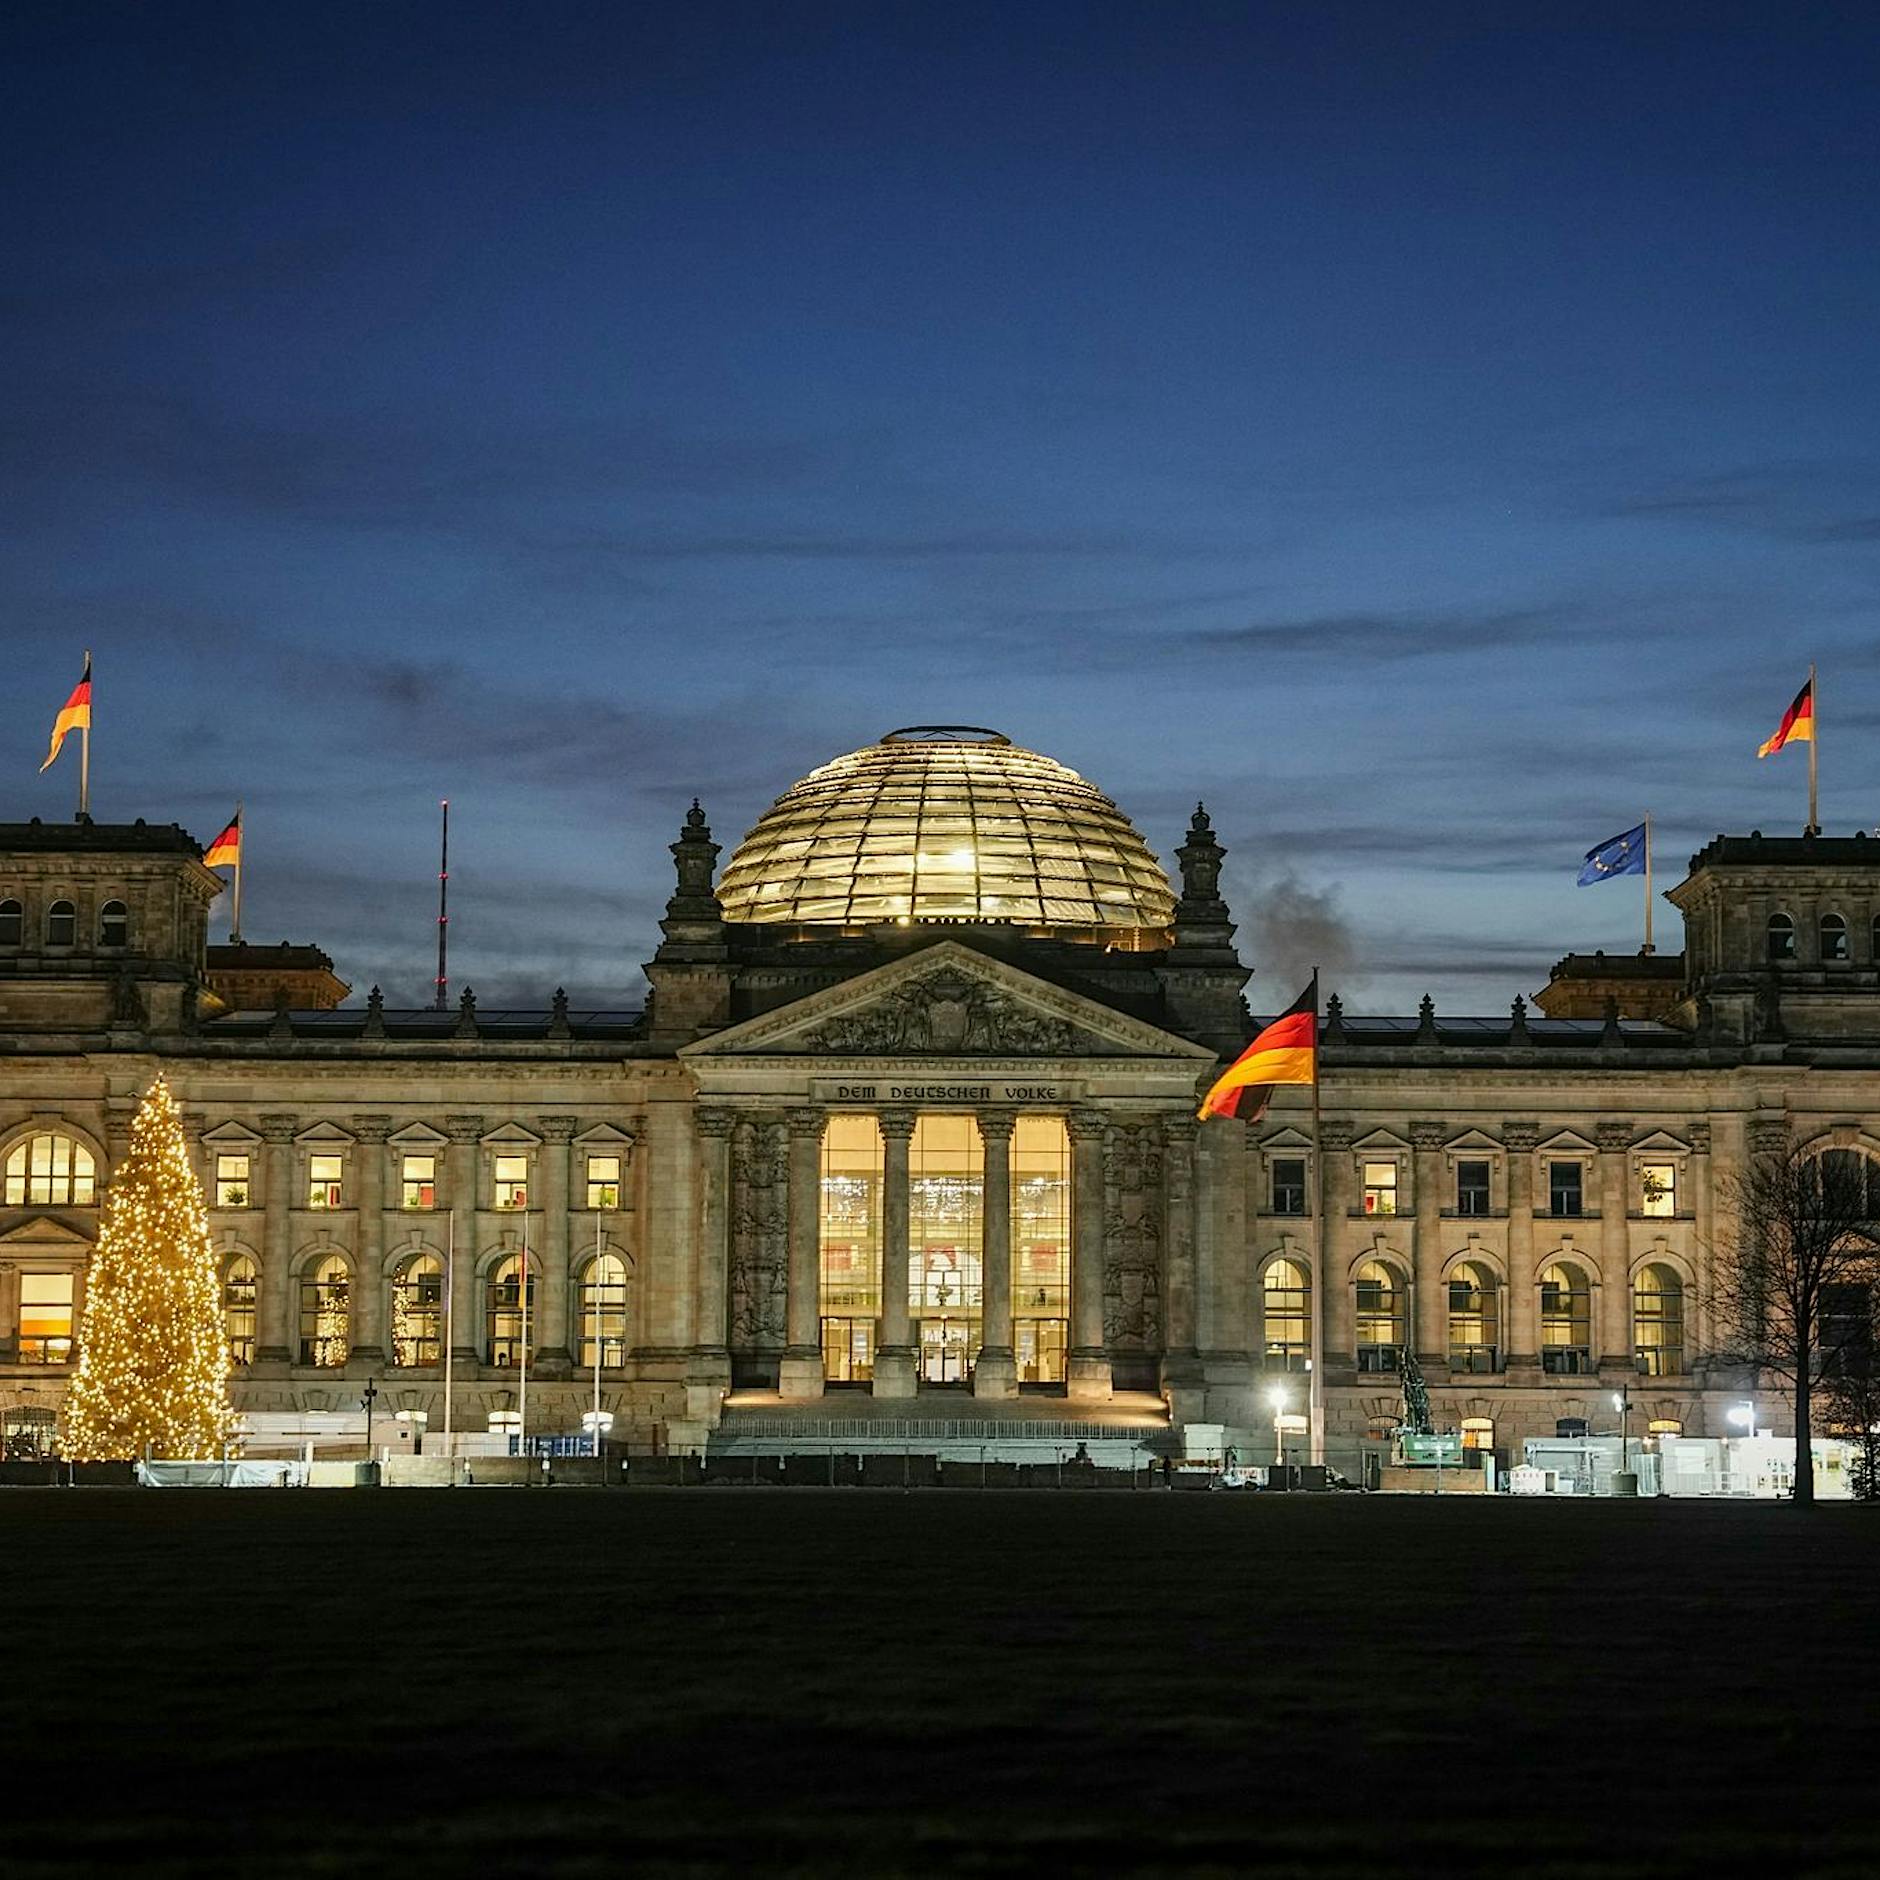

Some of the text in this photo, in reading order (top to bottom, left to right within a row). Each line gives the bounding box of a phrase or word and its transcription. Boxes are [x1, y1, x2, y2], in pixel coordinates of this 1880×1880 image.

[838, 1086, 1057, 1099] DEM DEUTSCHEN VOLKE
